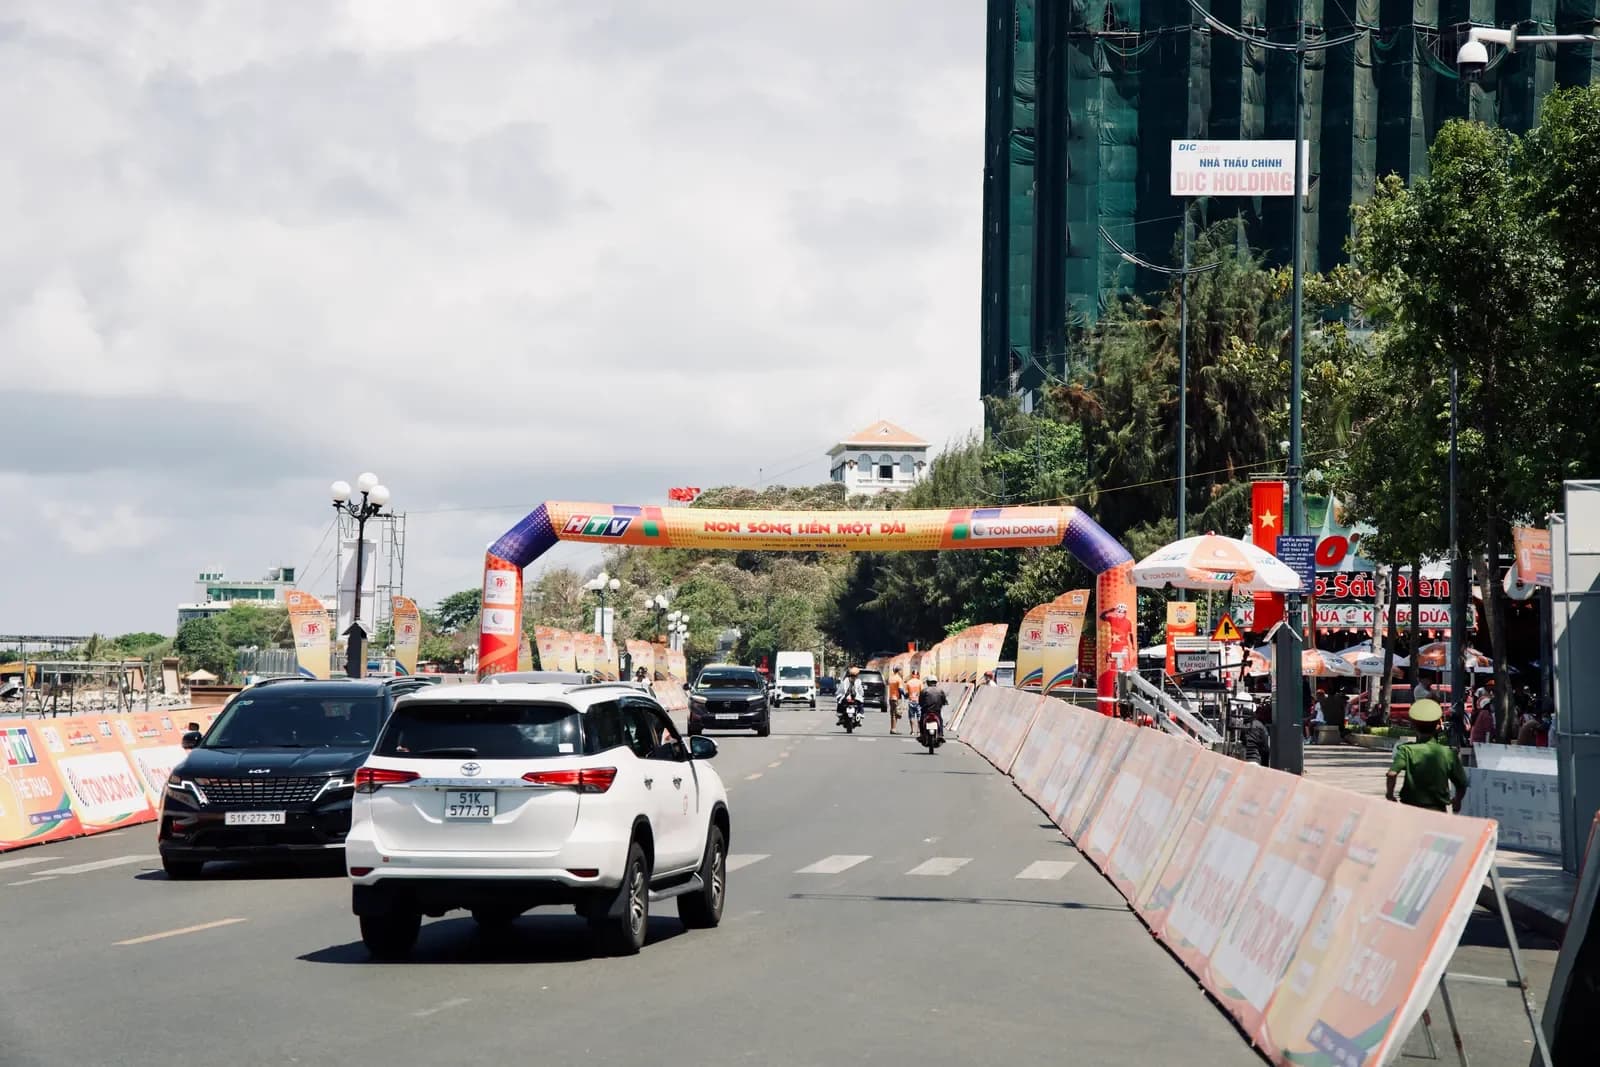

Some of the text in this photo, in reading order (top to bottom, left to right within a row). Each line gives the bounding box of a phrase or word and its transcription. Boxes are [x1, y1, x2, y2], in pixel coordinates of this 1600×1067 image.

[1178, 143, 1197, 151] DIC
[1251, 157, 1282, 168] CHÍNH
[1176, 171, 1293, 192] DIC HOLDING
[563, 515, 630, 535] HTV
[703, 521, 740, 533] NON
[837, 520, 873, 536] MỘT
[987, 525, 1010, 535] TON
[1046, 525, 1056, 534] A
[459, 792, 481, 804] 51K
[450, 804, 490, 817] 577.78
